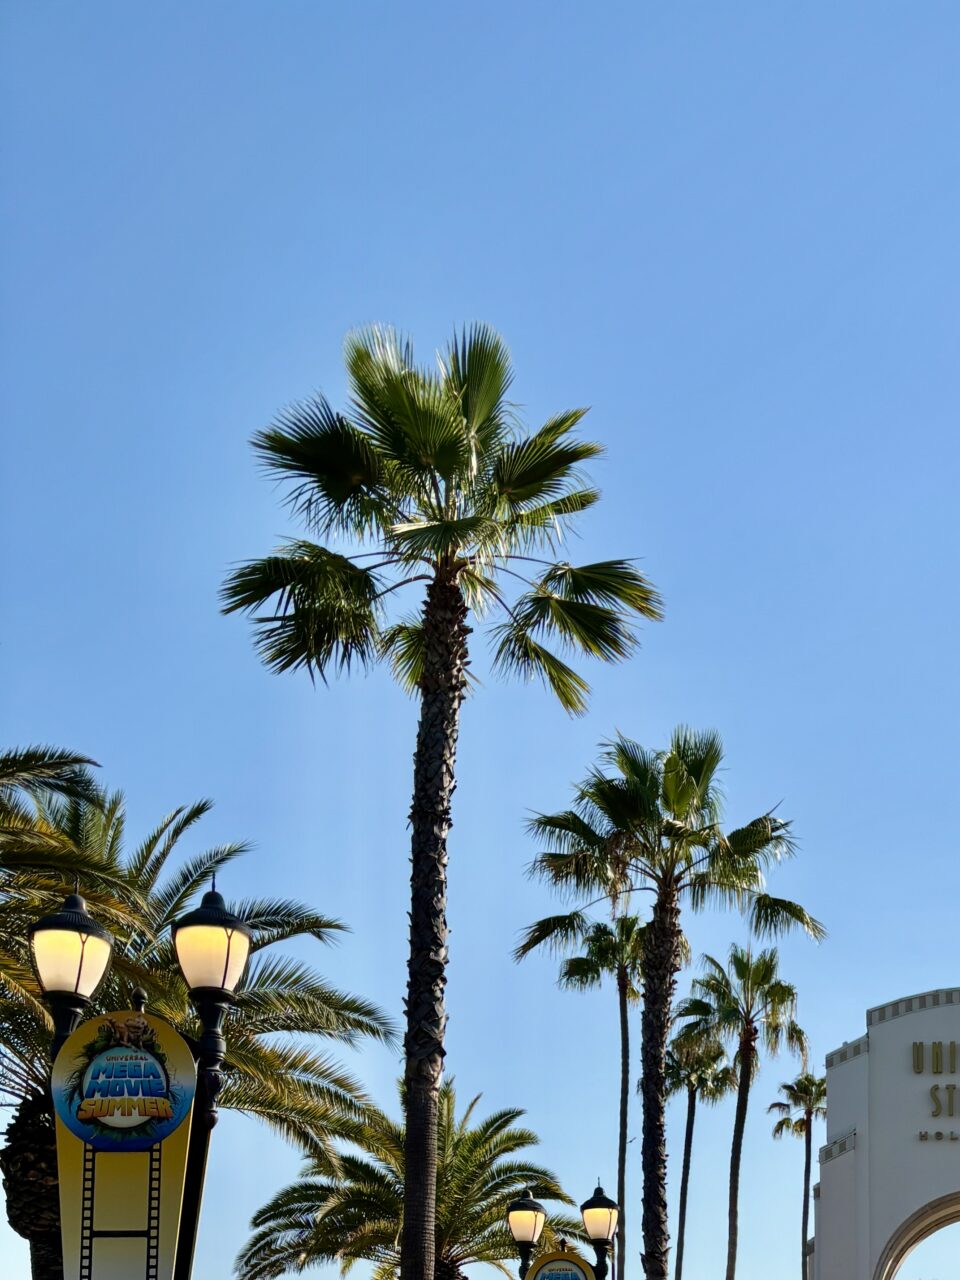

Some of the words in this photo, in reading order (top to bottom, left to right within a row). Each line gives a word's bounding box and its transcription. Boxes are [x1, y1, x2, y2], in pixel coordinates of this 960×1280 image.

[91, 1061, 161, 1080] MEGA
[84, 1079, 168, 1097] MOVIE
[76, 1097, 174, 1120] SUMMER
